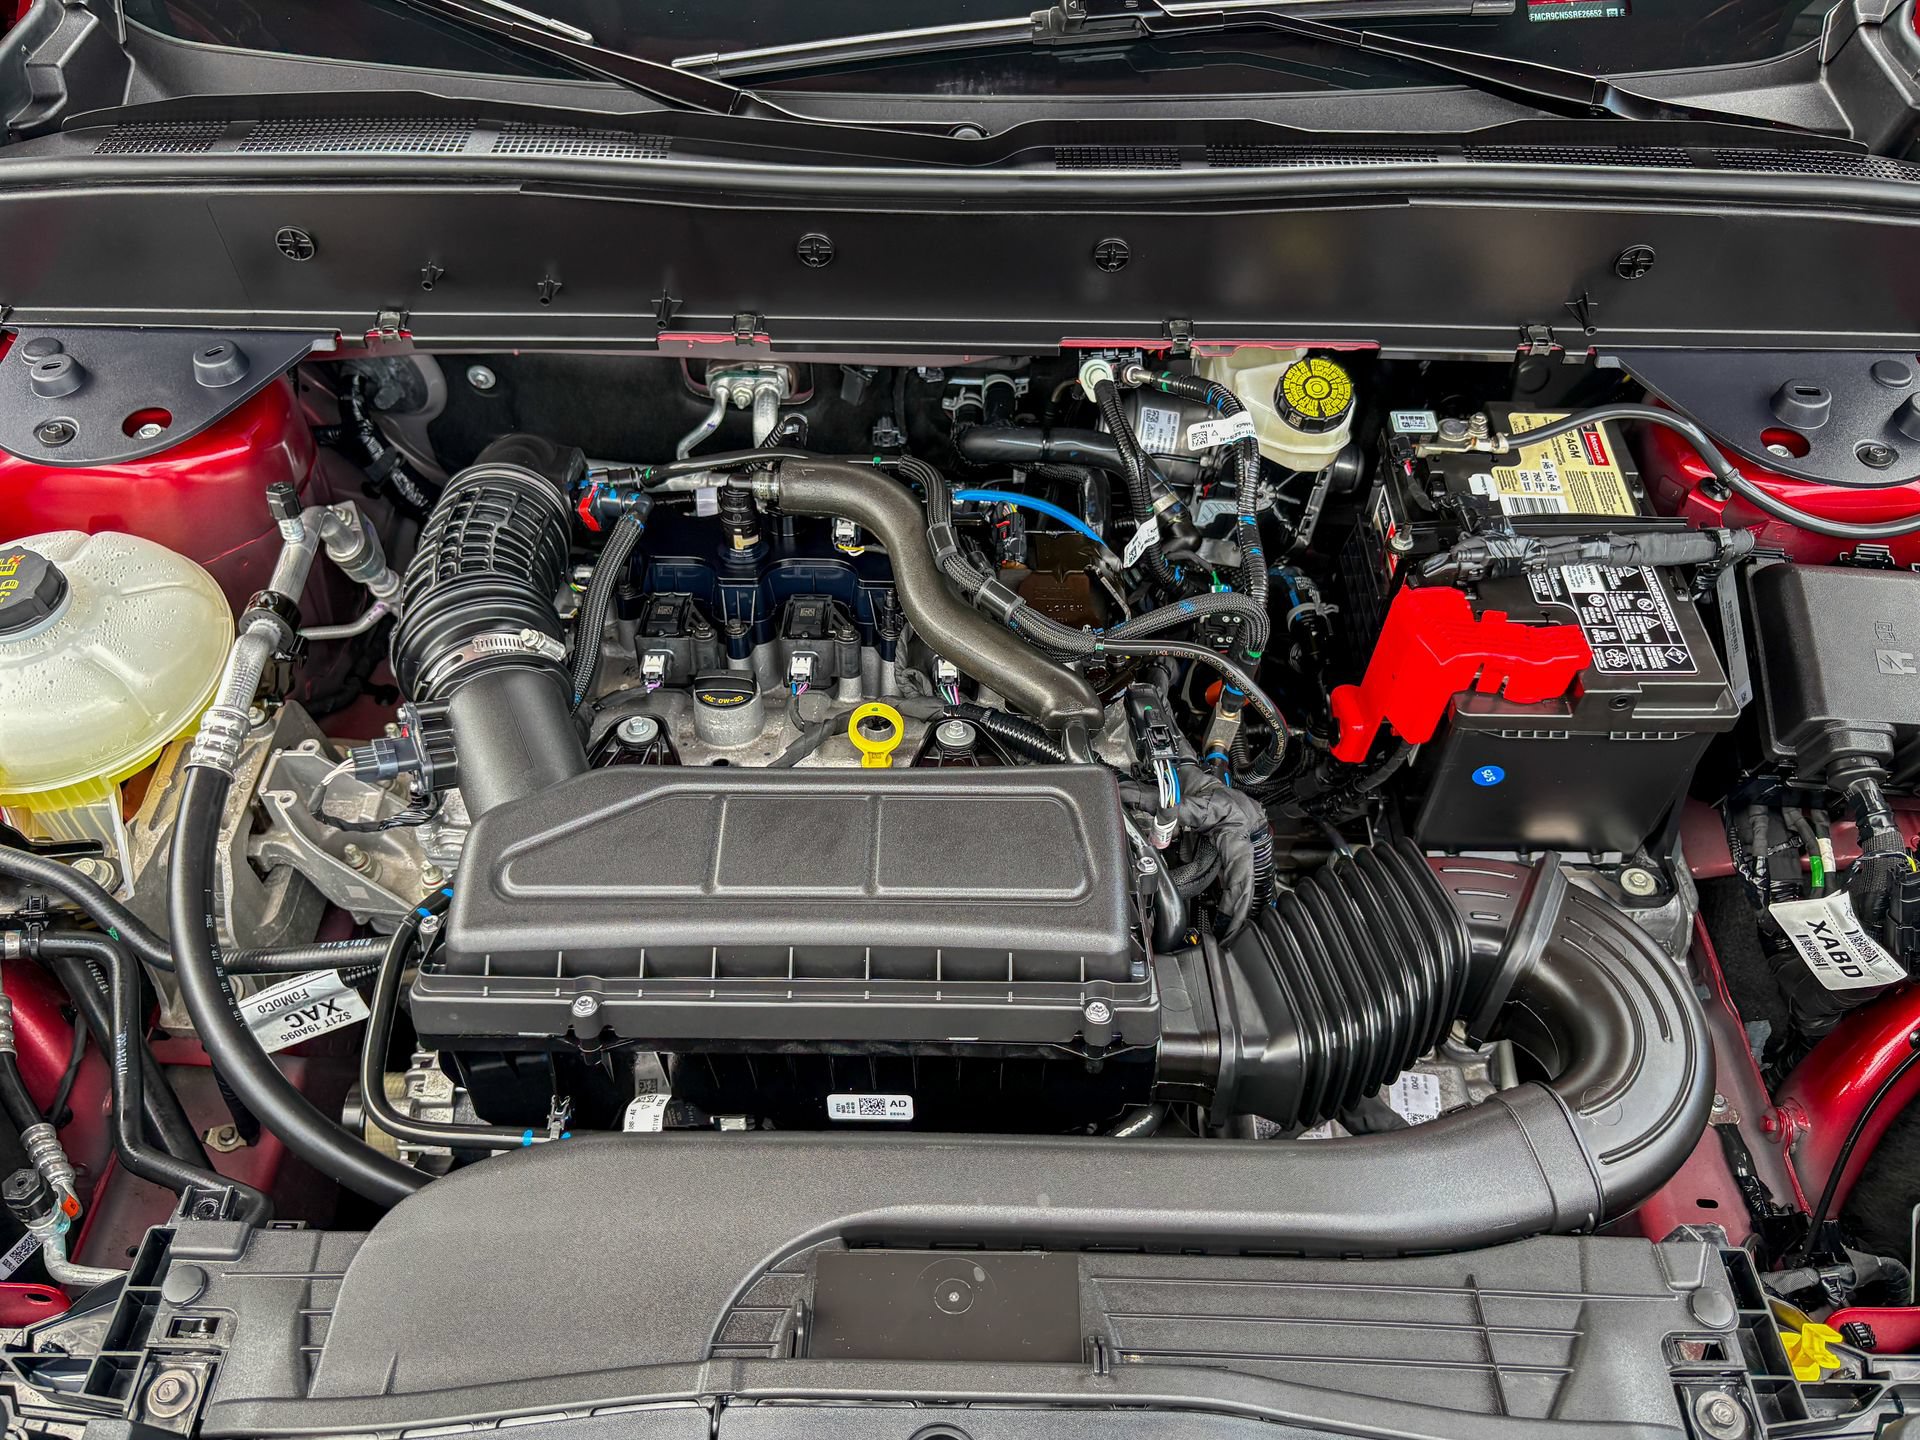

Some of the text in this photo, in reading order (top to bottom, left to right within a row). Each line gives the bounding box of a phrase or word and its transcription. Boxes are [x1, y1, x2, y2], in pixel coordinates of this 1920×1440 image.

[1589, 434, 1605, 464] Motorcraft
[1805, 919, 1864, 978] XABD
[257, 988, 311, 1014] FoMoCo
[284, 997, 343, 1029] XAC
[280, 1011, 352, 1043] SZ1T 19A095
[889, 1100, 907, 1108] AD
